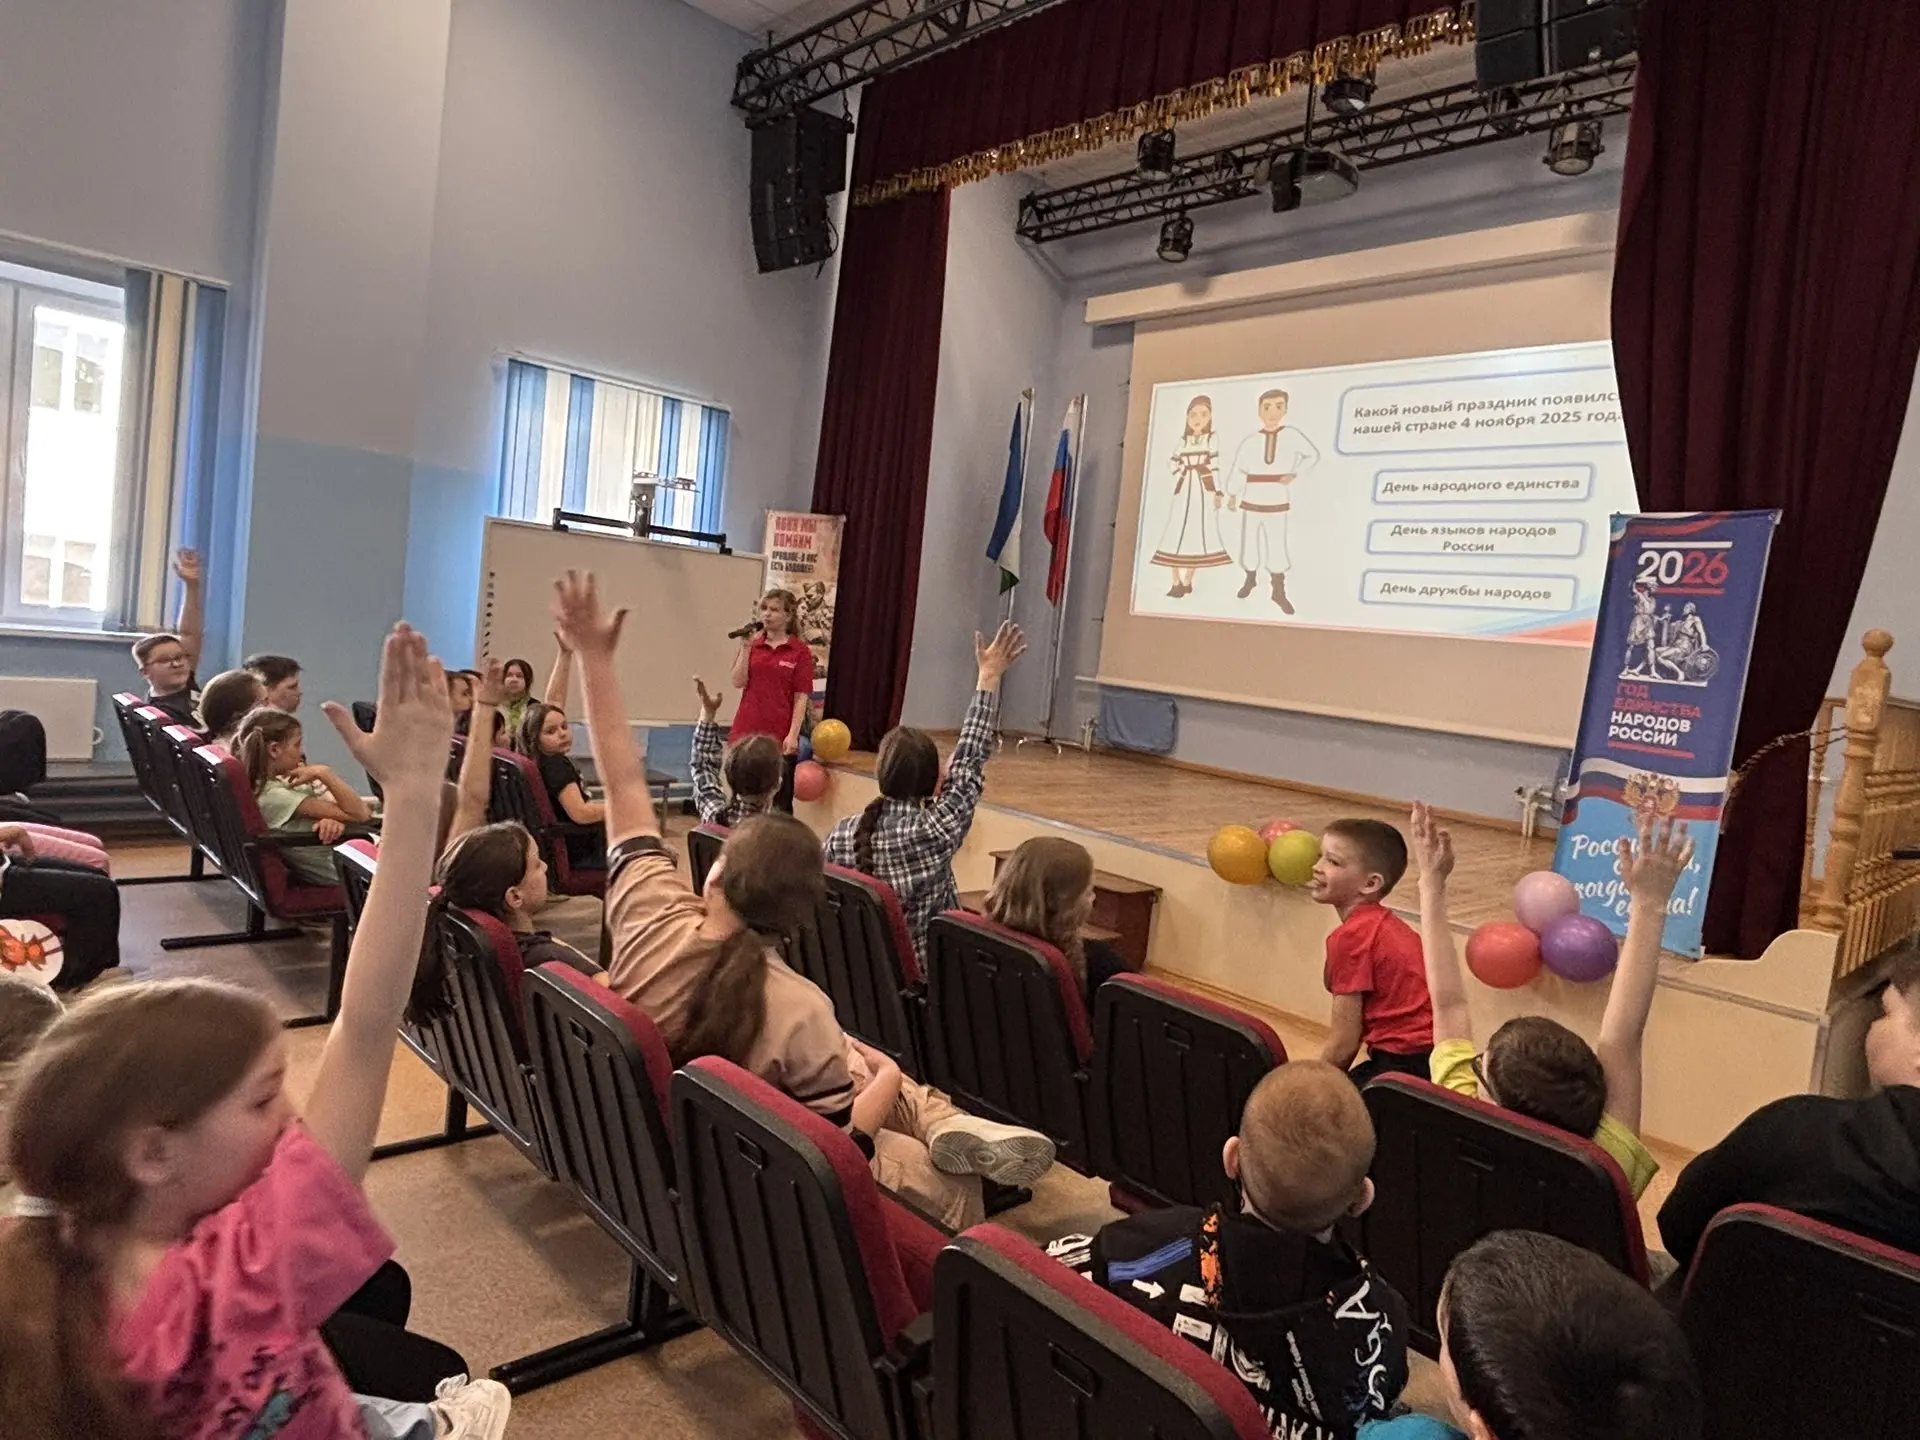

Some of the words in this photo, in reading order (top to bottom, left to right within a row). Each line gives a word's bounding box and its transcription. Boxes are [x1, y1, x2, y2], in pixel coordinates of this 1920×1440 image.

[1354, 404, 1399, 418] Какой
[1402, 400, 1453, 415] новый
[1457, 397, 1537, 413] праздник
[1541, 392, 1617, 406] появилс
[1353, 421, 1401, 434] нашей
[1405, 419, 1457, 434] стране
[1460, 417, 1471, 428] 4
[1475, 413, 1535, 429] ноября
[1540, 411, 1582, 425] 2025
[1587, 411, 1621, 423] год
[1382, 482, 1418, 494] День
[1422, 480, 1502, 494] народного
[1506, 478, 1580, 491] единства
[1390, 525, 1427, 536] День
[1431, 526, 1485, 535] языков
[1489, 526, 1556, 538] народов
[1442, 541, 1494, 552] России
[1638, 550, 1729, 584] 2026
[1380, 583, 1416, 594] День
[1419, 585, 1480, 600] дружбы
[1484, 588, 1551, 601] народов
[1616, 682, 1649, 699] ГОД
[1611, 711, 1691, 732] НАРОДОВ
[1608, 725, 1678, 746] РОССИИ
[1571, 834, 1641, 860] Росси
